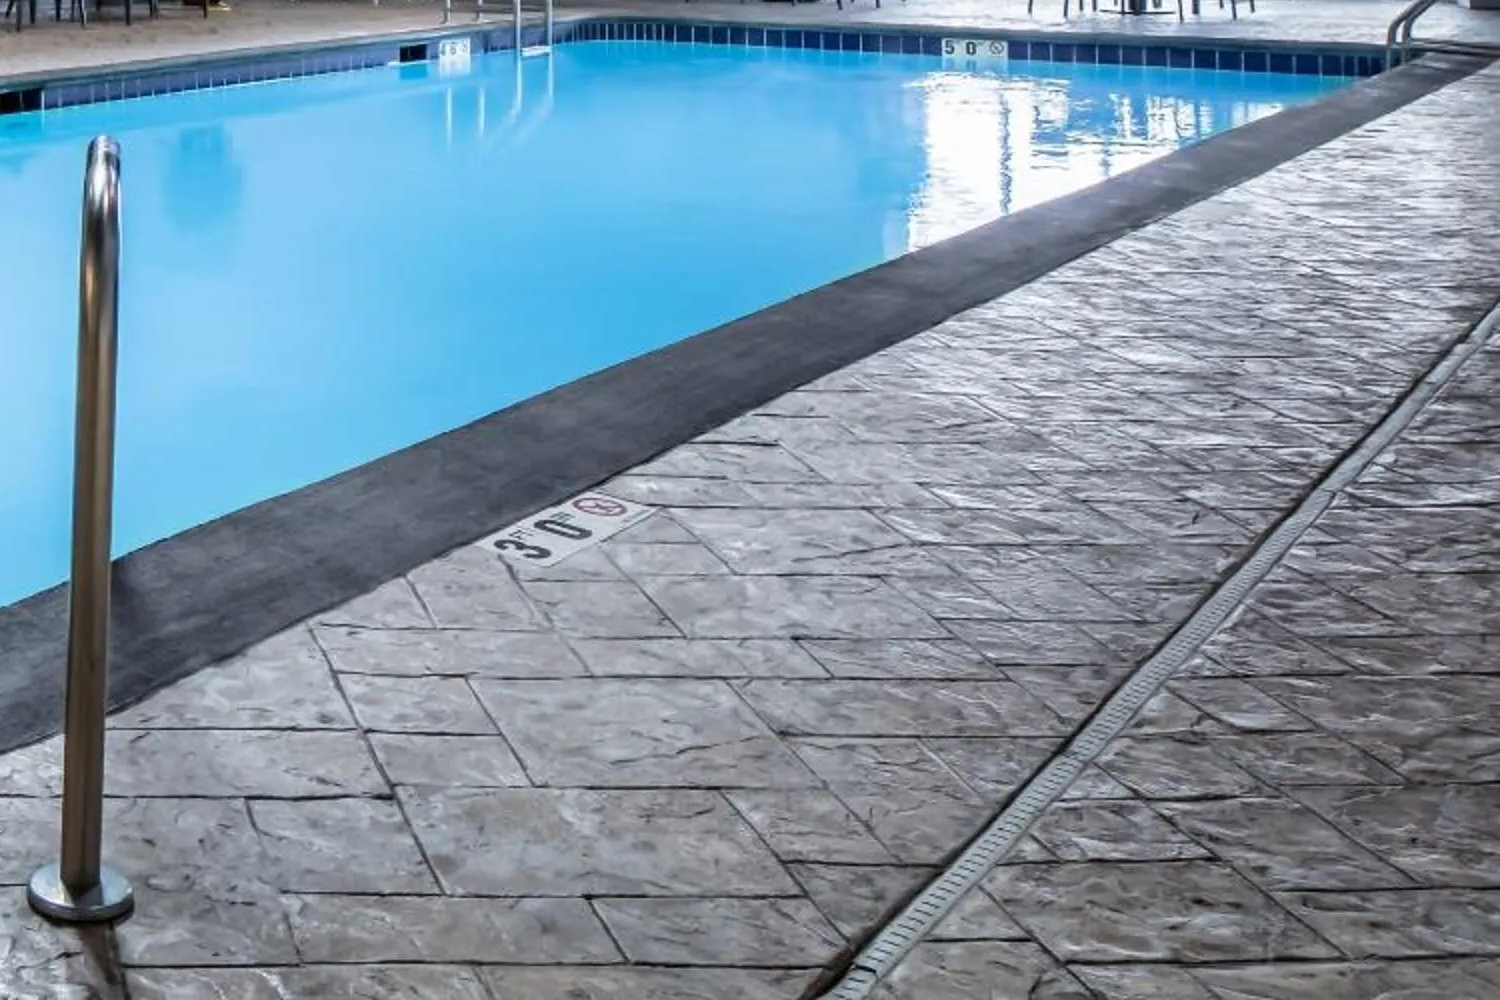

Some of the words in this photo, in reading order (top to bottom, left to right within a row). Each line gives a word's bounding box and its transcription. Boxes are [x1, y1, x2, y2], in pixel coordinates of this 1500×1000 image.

[945, 39, 955, 55] 5
[965, 41, 977, 56] 0
[493, 538, 552, 559] 3
[533, 518, 593, 540] 0
